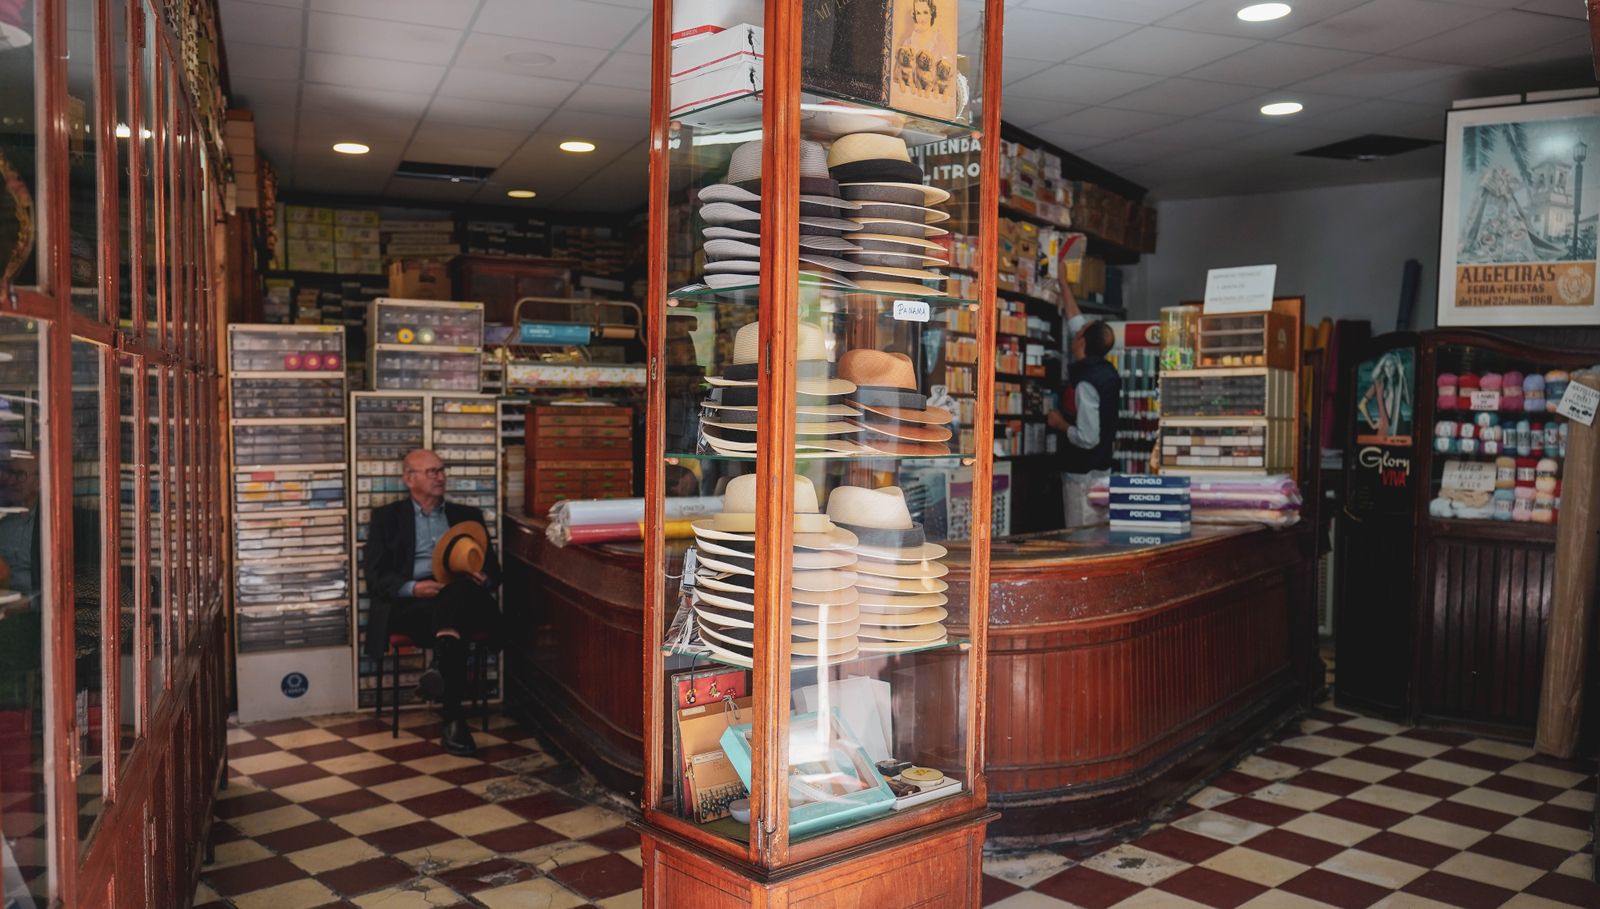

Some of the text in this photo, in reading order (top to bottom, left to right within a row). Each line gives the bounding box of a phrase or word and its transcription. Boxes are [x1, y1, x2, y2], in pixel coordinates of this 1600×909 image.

[925, 138, 981, 156] TIENDA
[923, 162, 980, 181] ITRO
[1460, 264, 1556, 283] ALGECIRAS
[1467, 285, 1496, 294] FERIA
[1503, 284, 1545, 294] FIESTAS
[897, 303, 926, 315] PANAMA
[1359, 446, 1410, 476] Glory
[1129, 477, 1162, 485] POCHOLO
